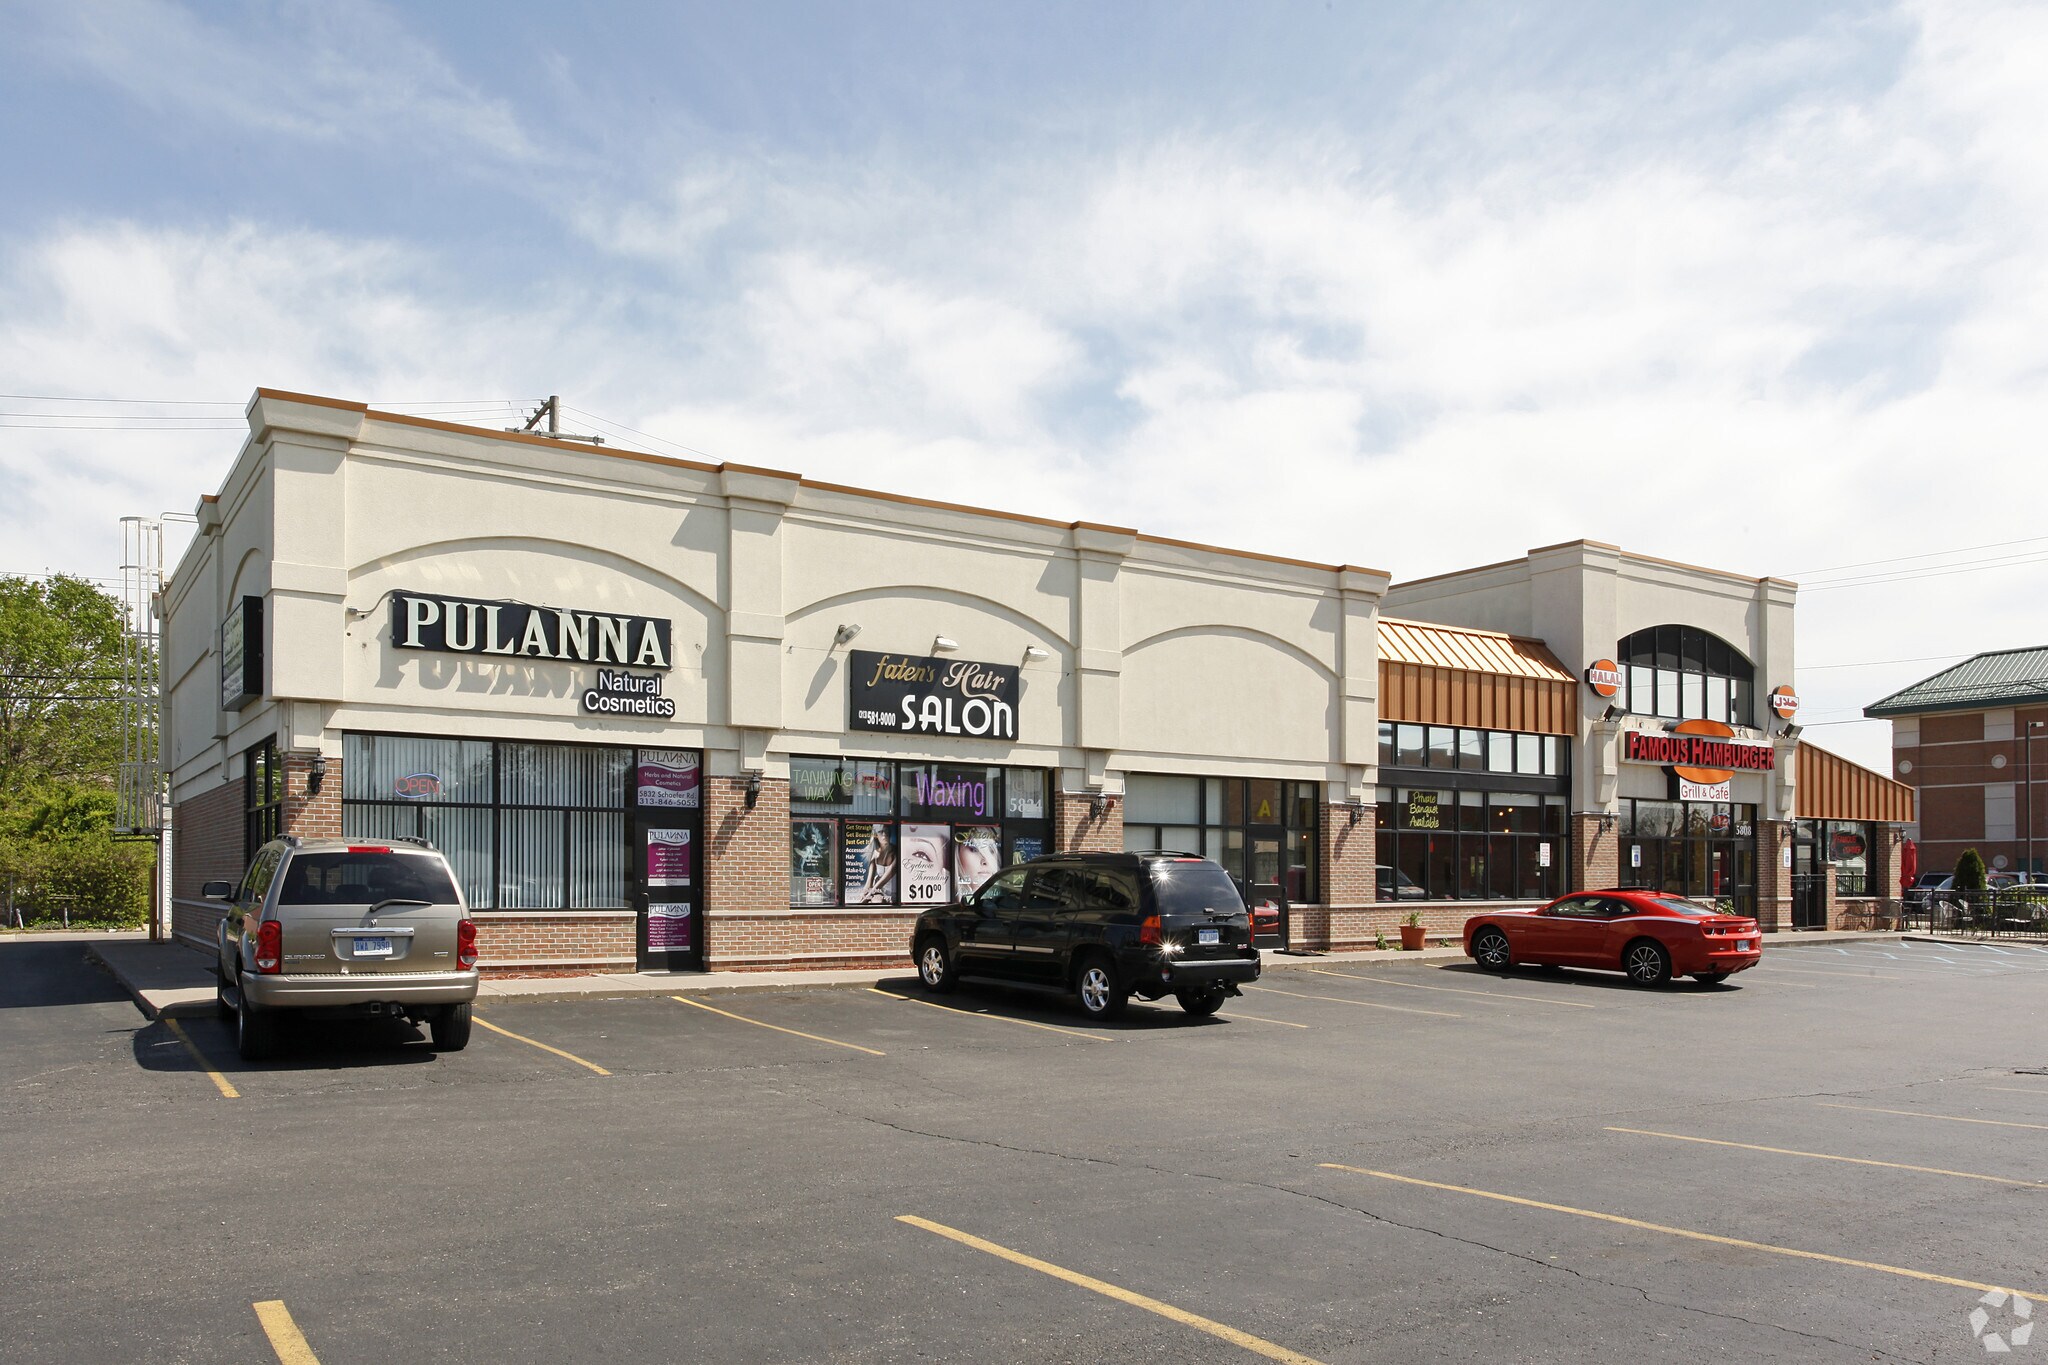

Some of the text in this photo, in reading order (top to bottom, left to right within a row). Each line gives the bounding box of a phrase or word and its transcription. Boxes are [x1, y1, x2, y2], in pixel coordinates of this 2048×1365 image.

[402, 597, 669, 667] PULANNA
[599, 672, 662, 695] Natural
[942, 662, 1005, 702] Hair
[1591, 670, 1621, 686] HALAL
[585, 691, 675, 715] Cosmetics
[1775, 697, 1797, 707] حلال
[901, 694, 1013, 738] SALON
[1627, 731, 1775, 770] FAMOUS HAMBURGER
[395, 777, 439, 795] OPEN
[793, 769, 853, 787] TANNING
[640, 790, 656, 798] 5832
[804, 786, 834, 802] WAX
[915, 772, 985, 816] Waxing
[1681, 784, 1729, 800] Grill & Café
[639, 798, 697, 806] 313-846-5055
[1257, 799, 1271, 817] A
[1735, 825, 1752, 836] 5808
